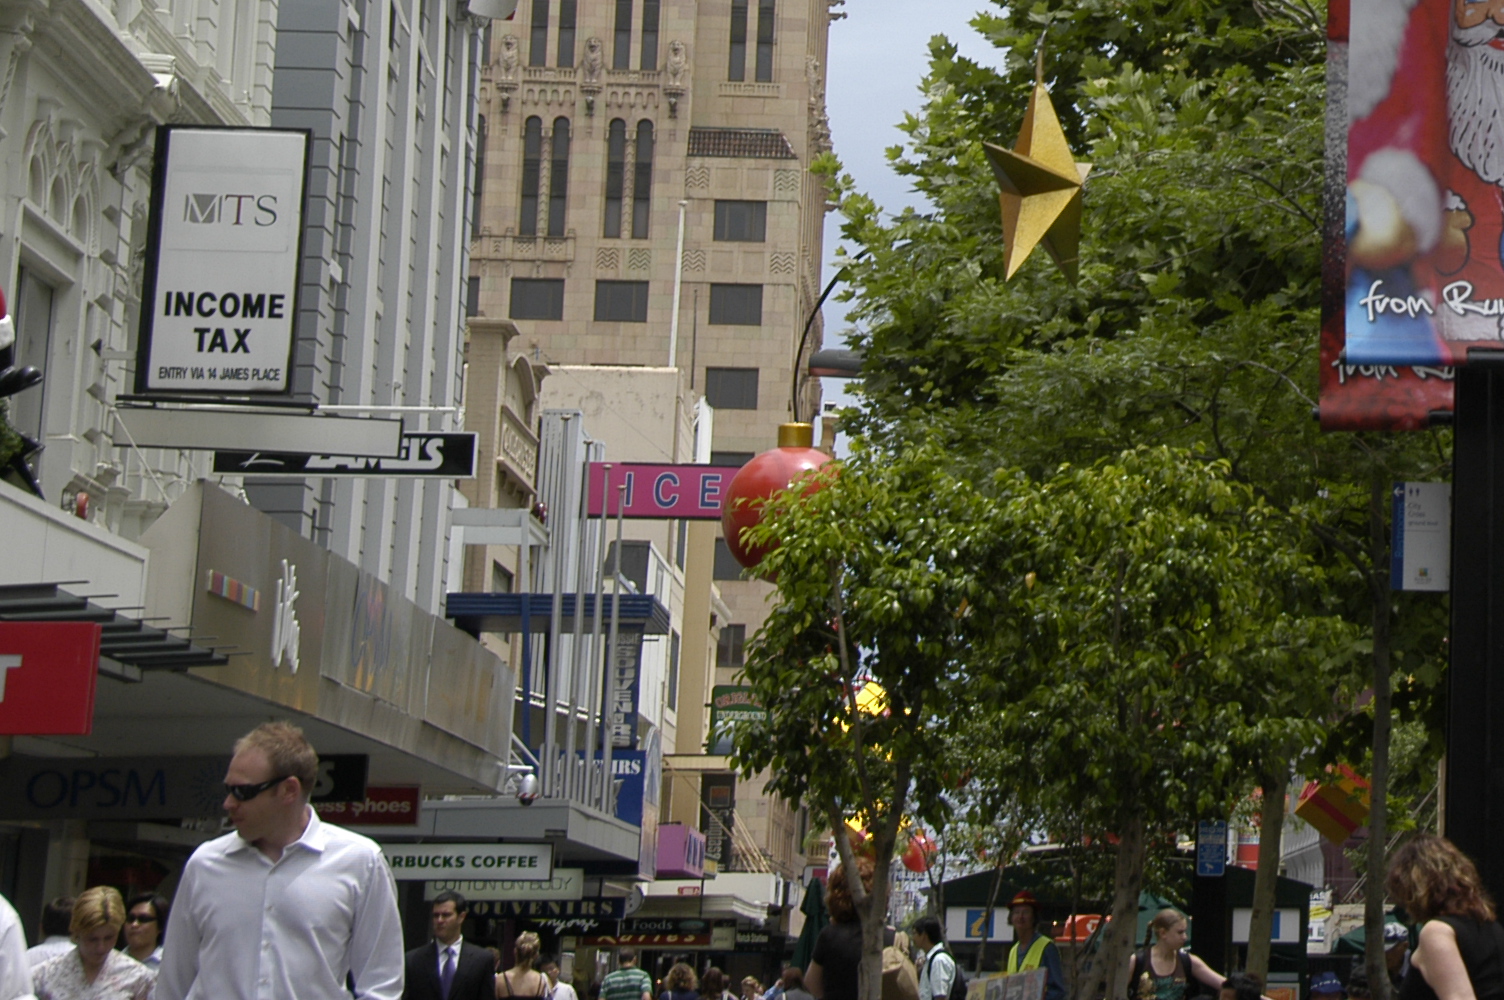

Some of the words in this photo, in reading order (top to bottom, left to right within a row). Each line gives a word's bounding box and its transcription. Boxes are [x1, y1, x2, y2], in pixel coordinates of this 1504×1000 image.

[163, 291, 286, 319] INCOME
[1359, 279, 1434, 322] from
[193, 327, 252, 354] TAX
[158, 366, 188, 381] ENTRY
[190, 367, 205, 380] VIA
[207, 367, 217, 380] 14
[219, 367, 249, 381] JAMES
[251, 368, 281, 382] PLACE
[26, 768, 167, 809] OPSM
[471, 855, 538, 869] COFFEE
[466, 901, 613, 915] OUVENIRS
[632, 919, 673, 930] Foods
